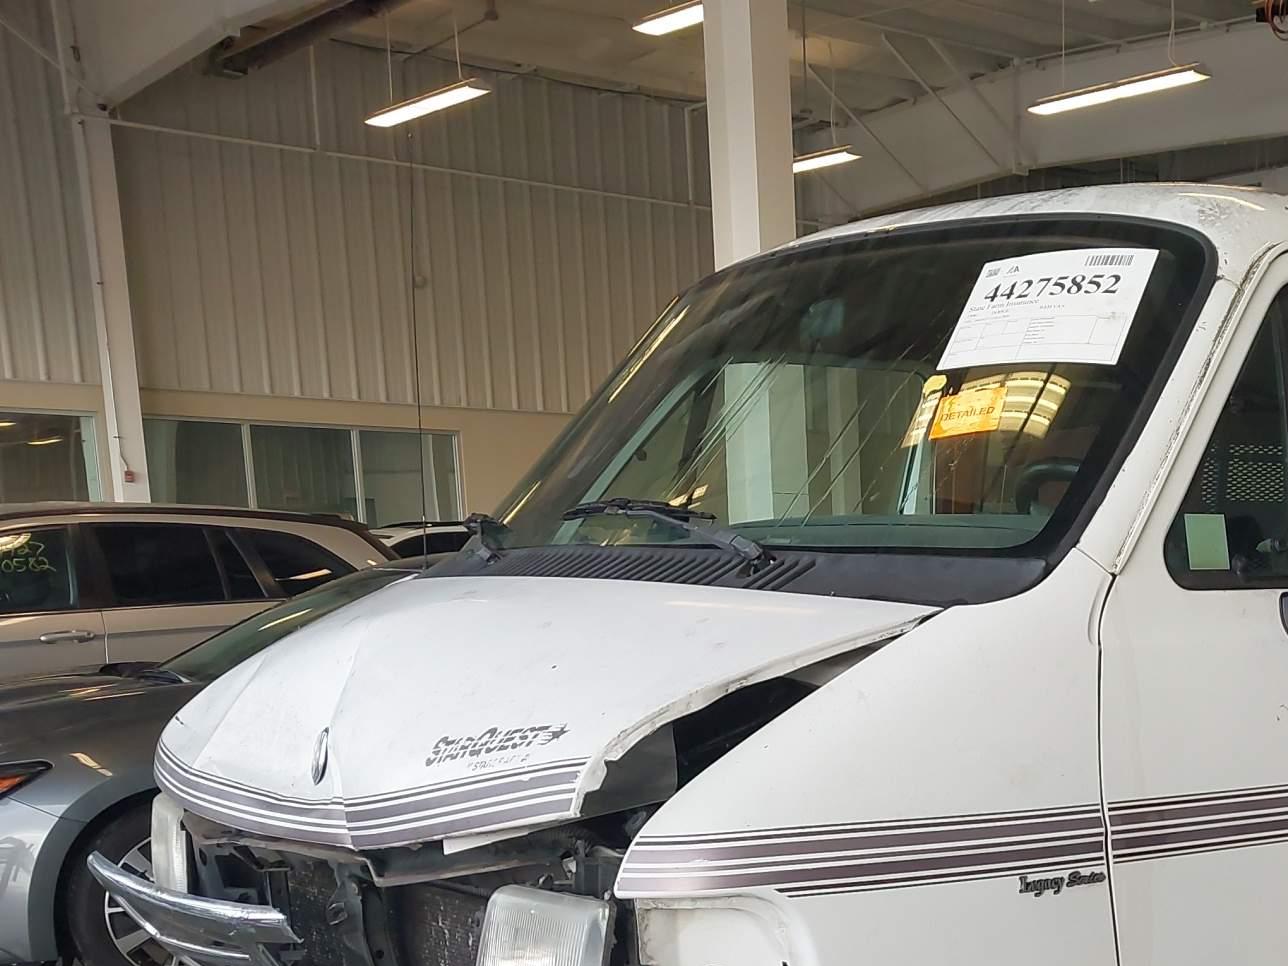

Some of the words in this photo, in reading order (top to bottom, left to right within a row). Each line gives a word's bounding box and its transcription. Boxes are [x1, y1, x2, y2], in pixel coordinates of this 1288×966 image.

[984, 274, 1122, 303] 44275852
[940, 406, 996, 422] DETAILED
[1018, 875, 1065, 898] Legacy
